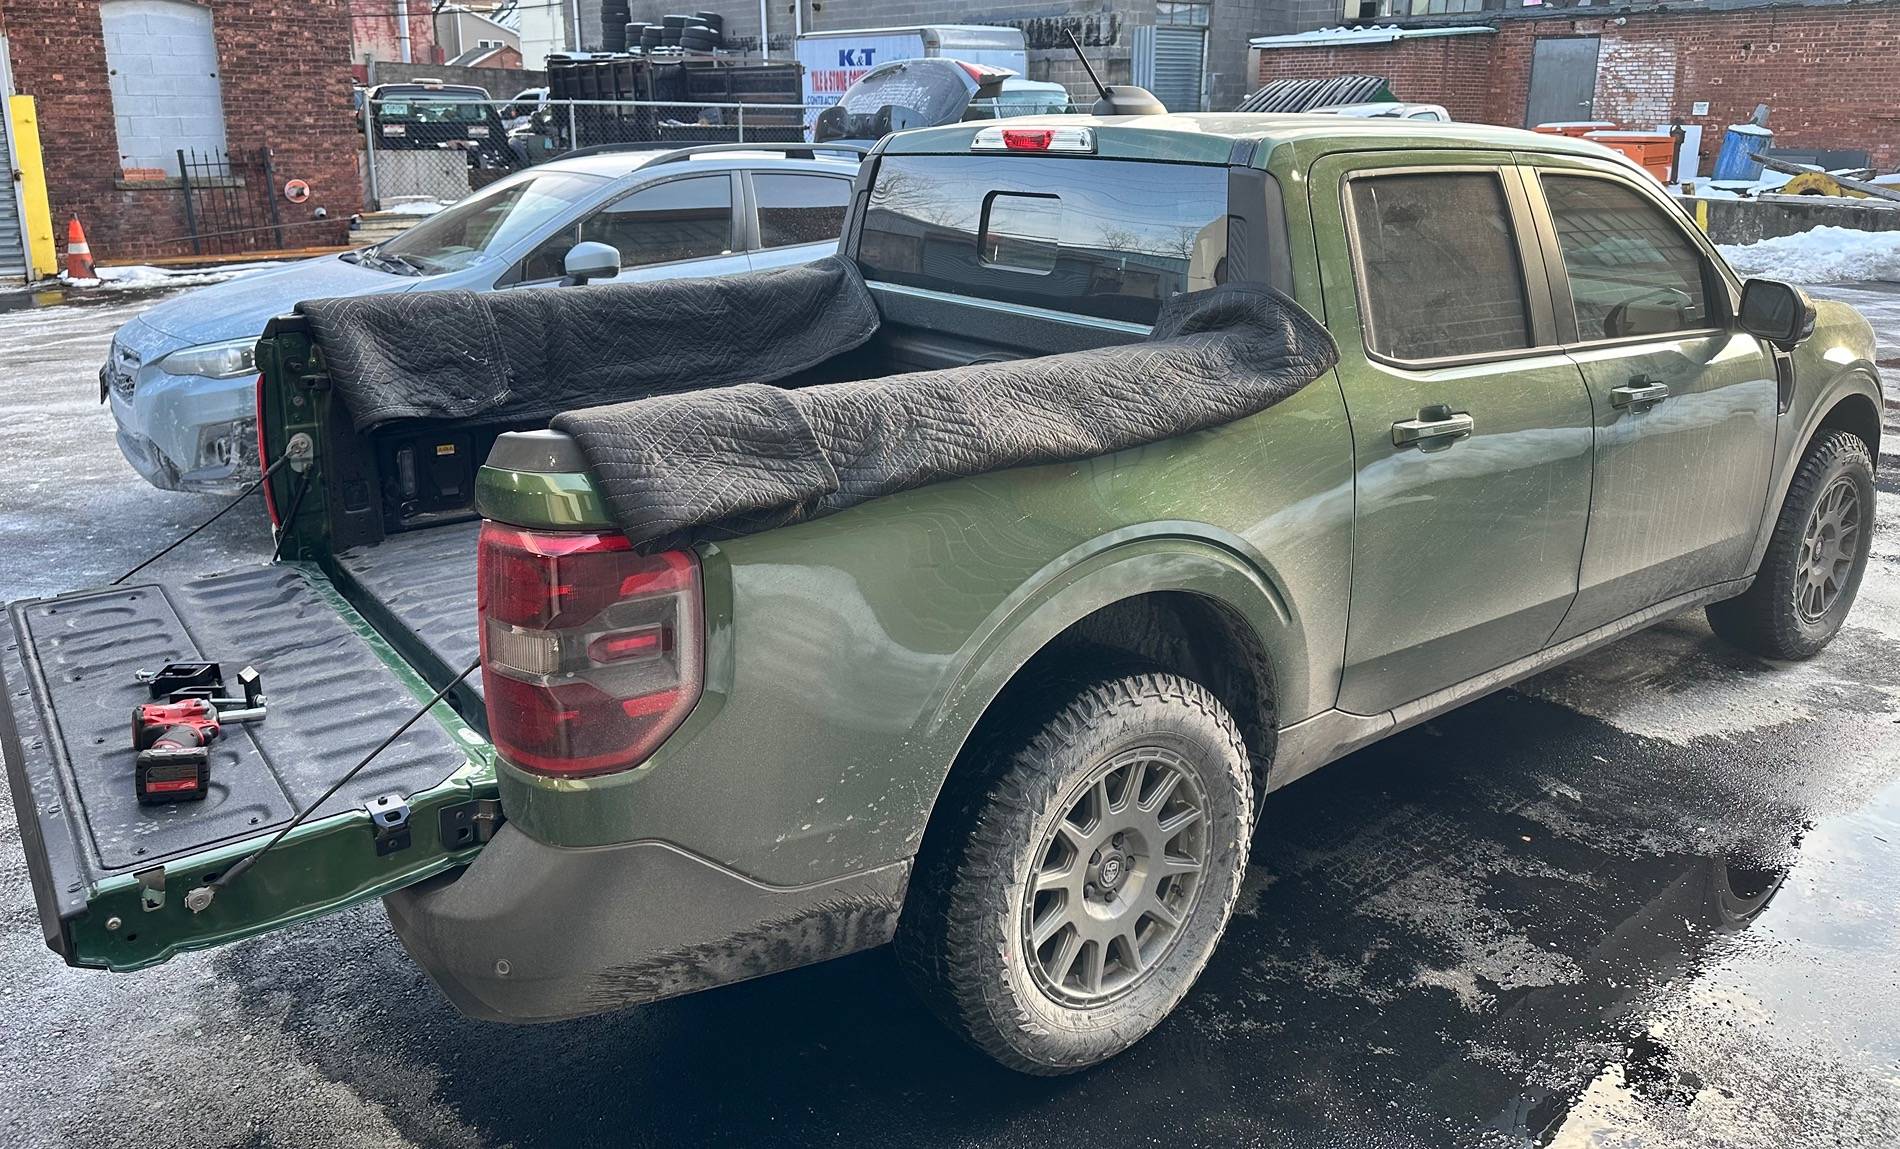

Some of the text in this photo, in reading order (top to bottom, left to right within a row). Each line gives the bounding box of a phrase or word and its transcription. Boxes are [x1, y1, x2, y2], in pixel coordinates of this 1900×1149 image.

[839, 48, 876, 66] K&T
[811, 70, 823, 91] TILE
[829, 70, 847, 91] STONE
